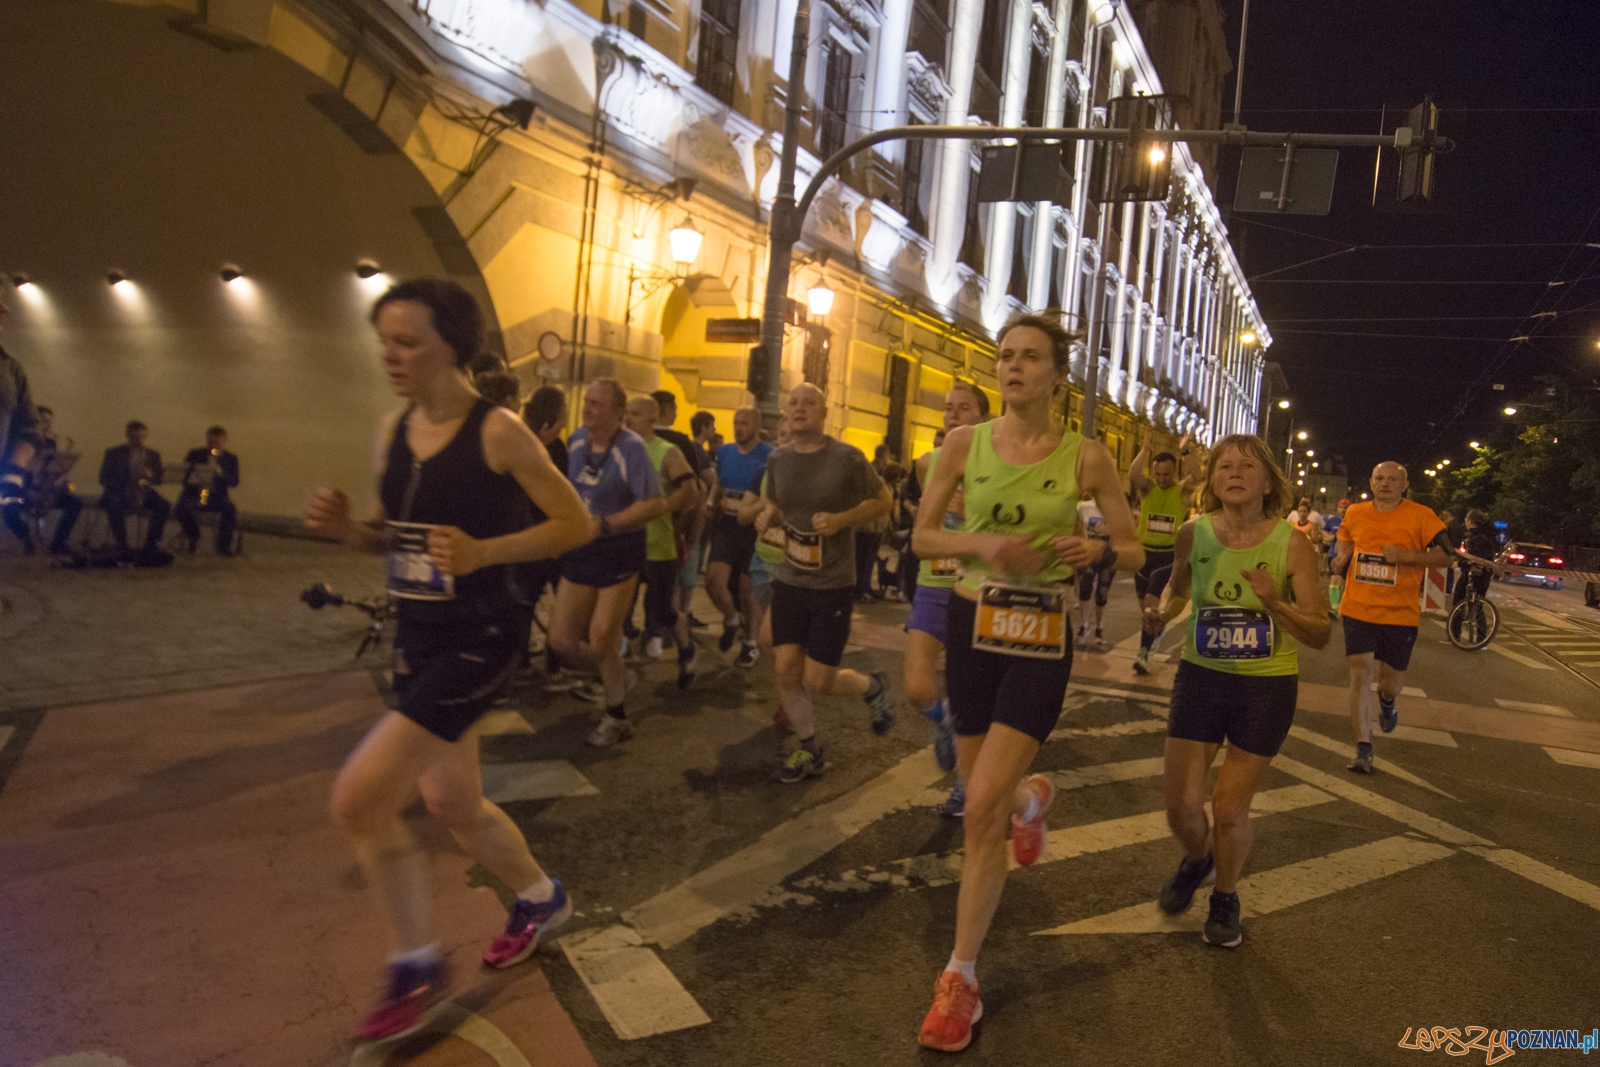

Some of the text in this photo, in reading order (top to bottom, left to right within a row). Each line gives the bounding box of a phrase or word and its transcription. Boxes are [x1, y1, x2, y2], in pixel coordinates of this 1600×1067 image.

[1360, 564, 1389, 579] 6350
[992, 610, 1049, 642] 5621
[1206, 627, 1259, 649] 2944
